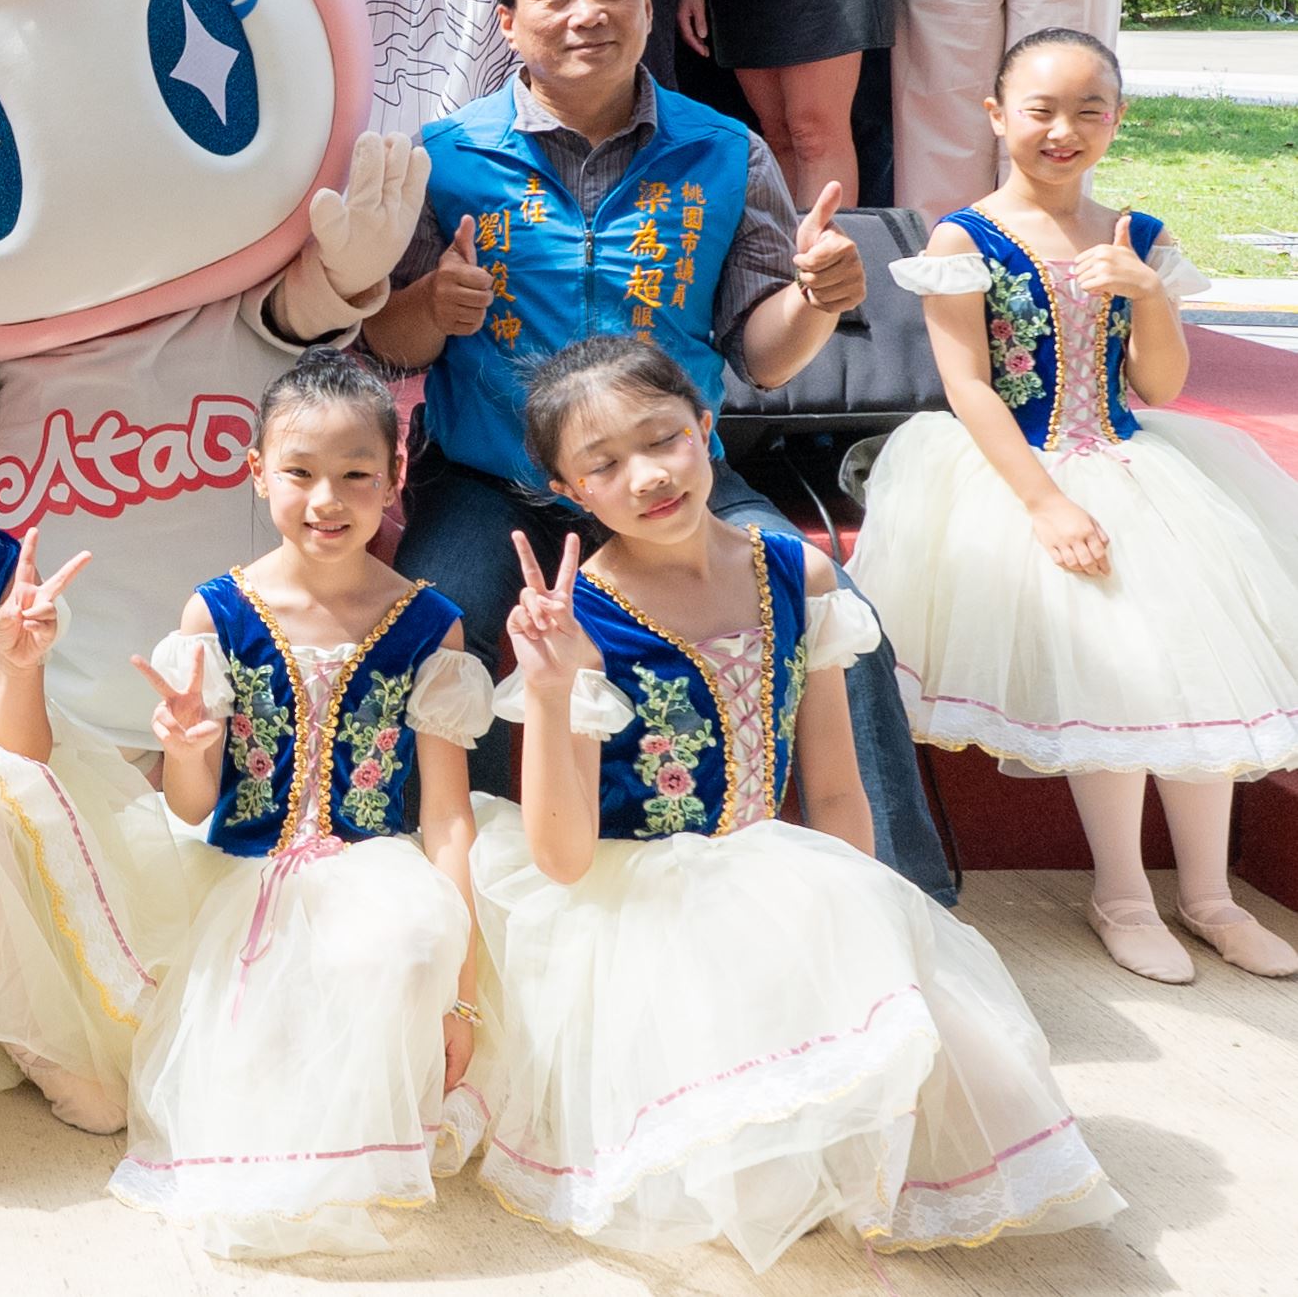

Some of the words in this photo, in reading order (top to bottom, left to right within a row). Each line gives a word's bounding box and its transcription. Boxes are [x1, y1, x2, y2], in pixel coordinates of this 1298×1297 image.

[519, 172, 548, 224] 主任
[623, 179, 673, 309] 梁為超
[669, 180, 708, 311] 桃園市議員
